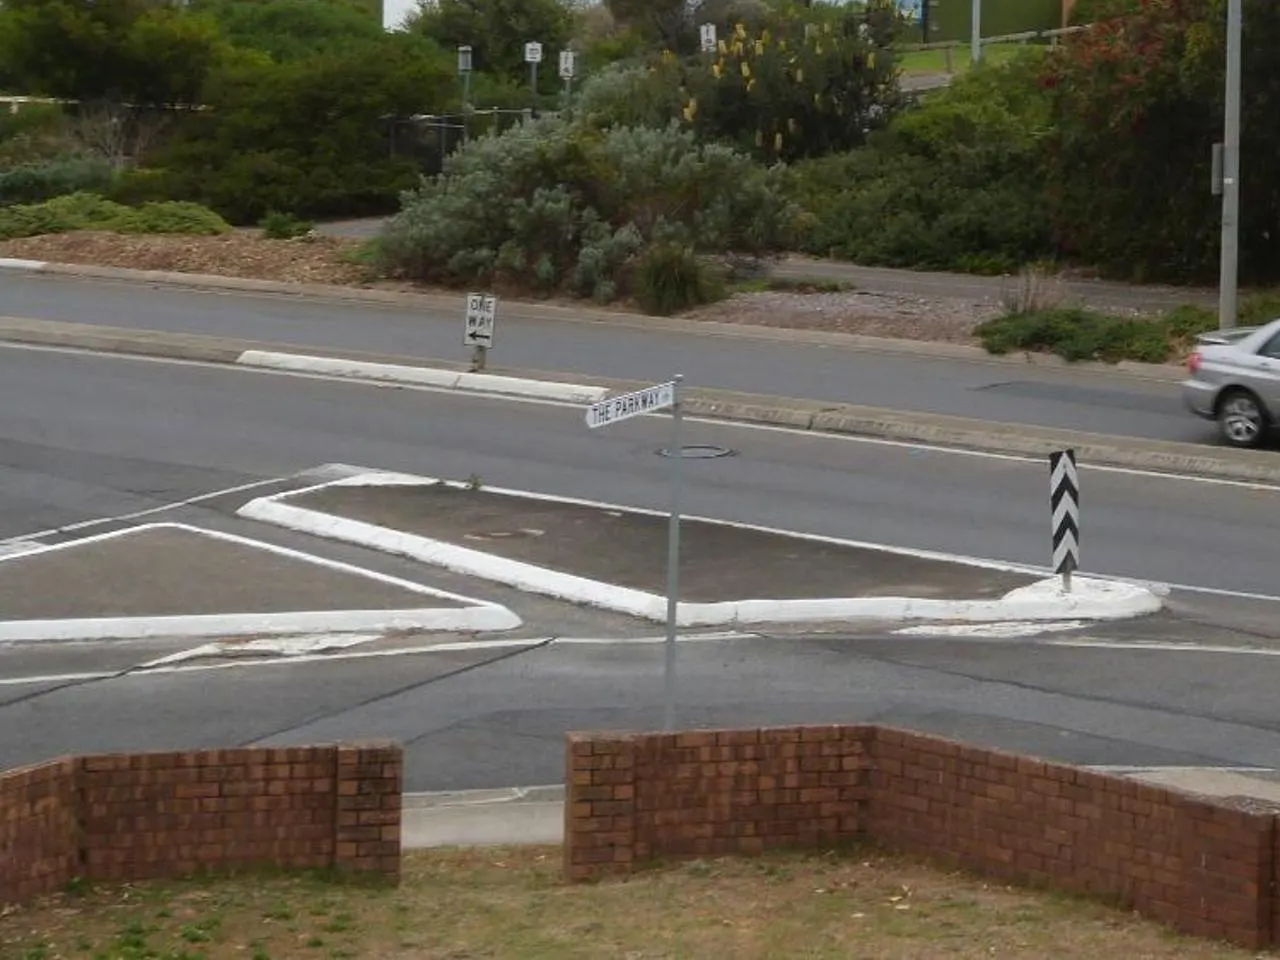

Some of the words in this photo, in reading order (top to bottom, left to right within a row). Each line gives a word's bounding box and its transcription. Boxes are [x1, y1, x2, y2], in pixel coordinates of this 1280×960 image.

[470, 298, 493, 313] ONE
[468, 315, 492, 329] WAY
[592, 403, 610, 425] THE
[616, 390, 660, 417] PARKWAY
